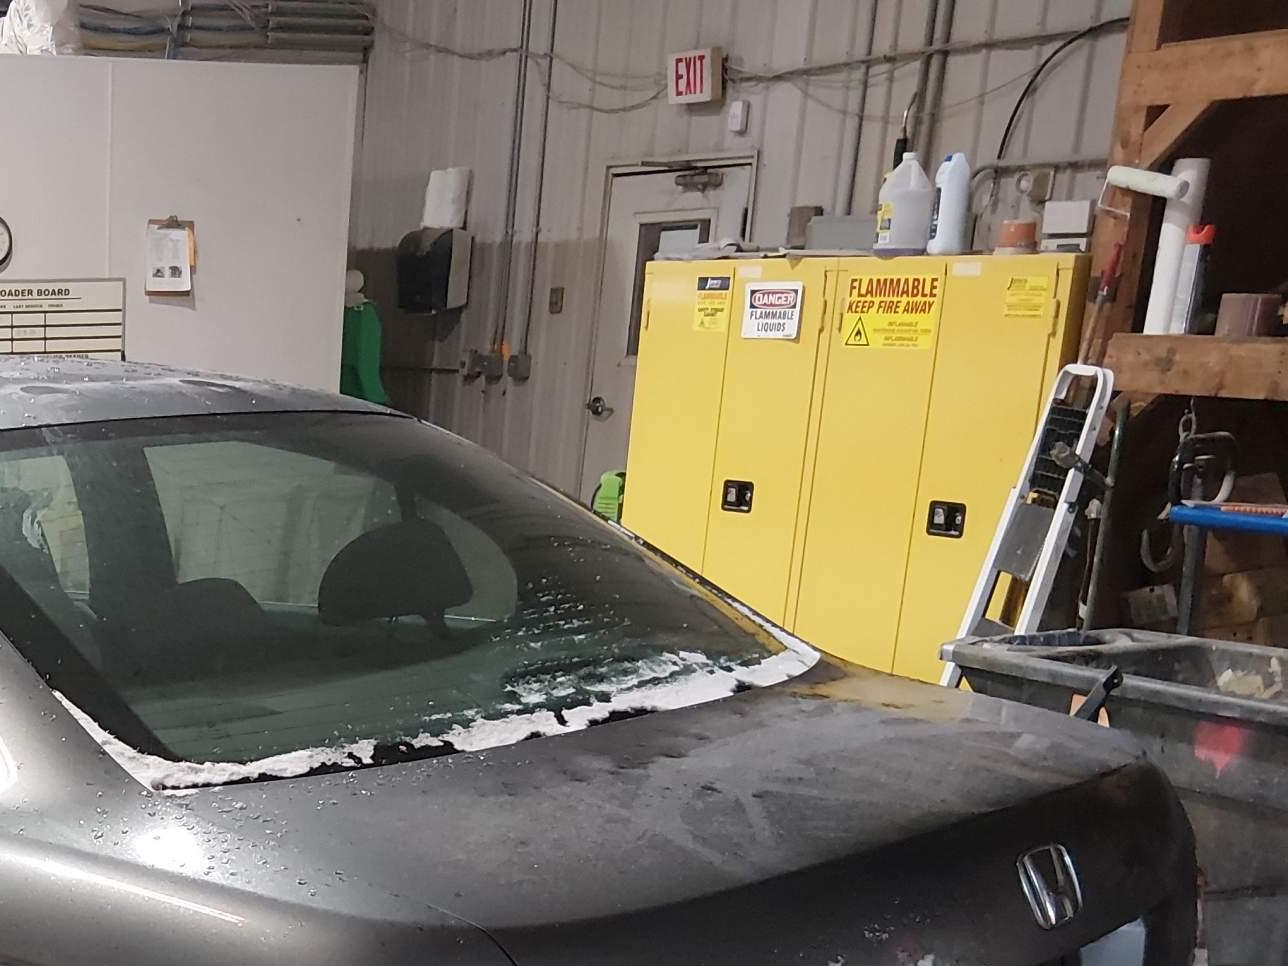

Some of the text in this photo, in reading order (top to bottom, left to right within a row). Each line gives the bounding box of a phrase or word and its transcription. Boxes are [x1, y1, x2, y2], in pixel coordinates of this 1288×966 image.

[675, 55, 705, 96] EXIT
[36, 288, 70, 297] BOARD
[849, 277, 939, 298] FLAMMABLE
[755, 293, 794, 305] DANGER
[846, 300, 934, 314] KEEP FIRE AWAY
[750, 310, 794, 320] FLAMMABLE
[757, 322, 786, 332] LIQUIDS
